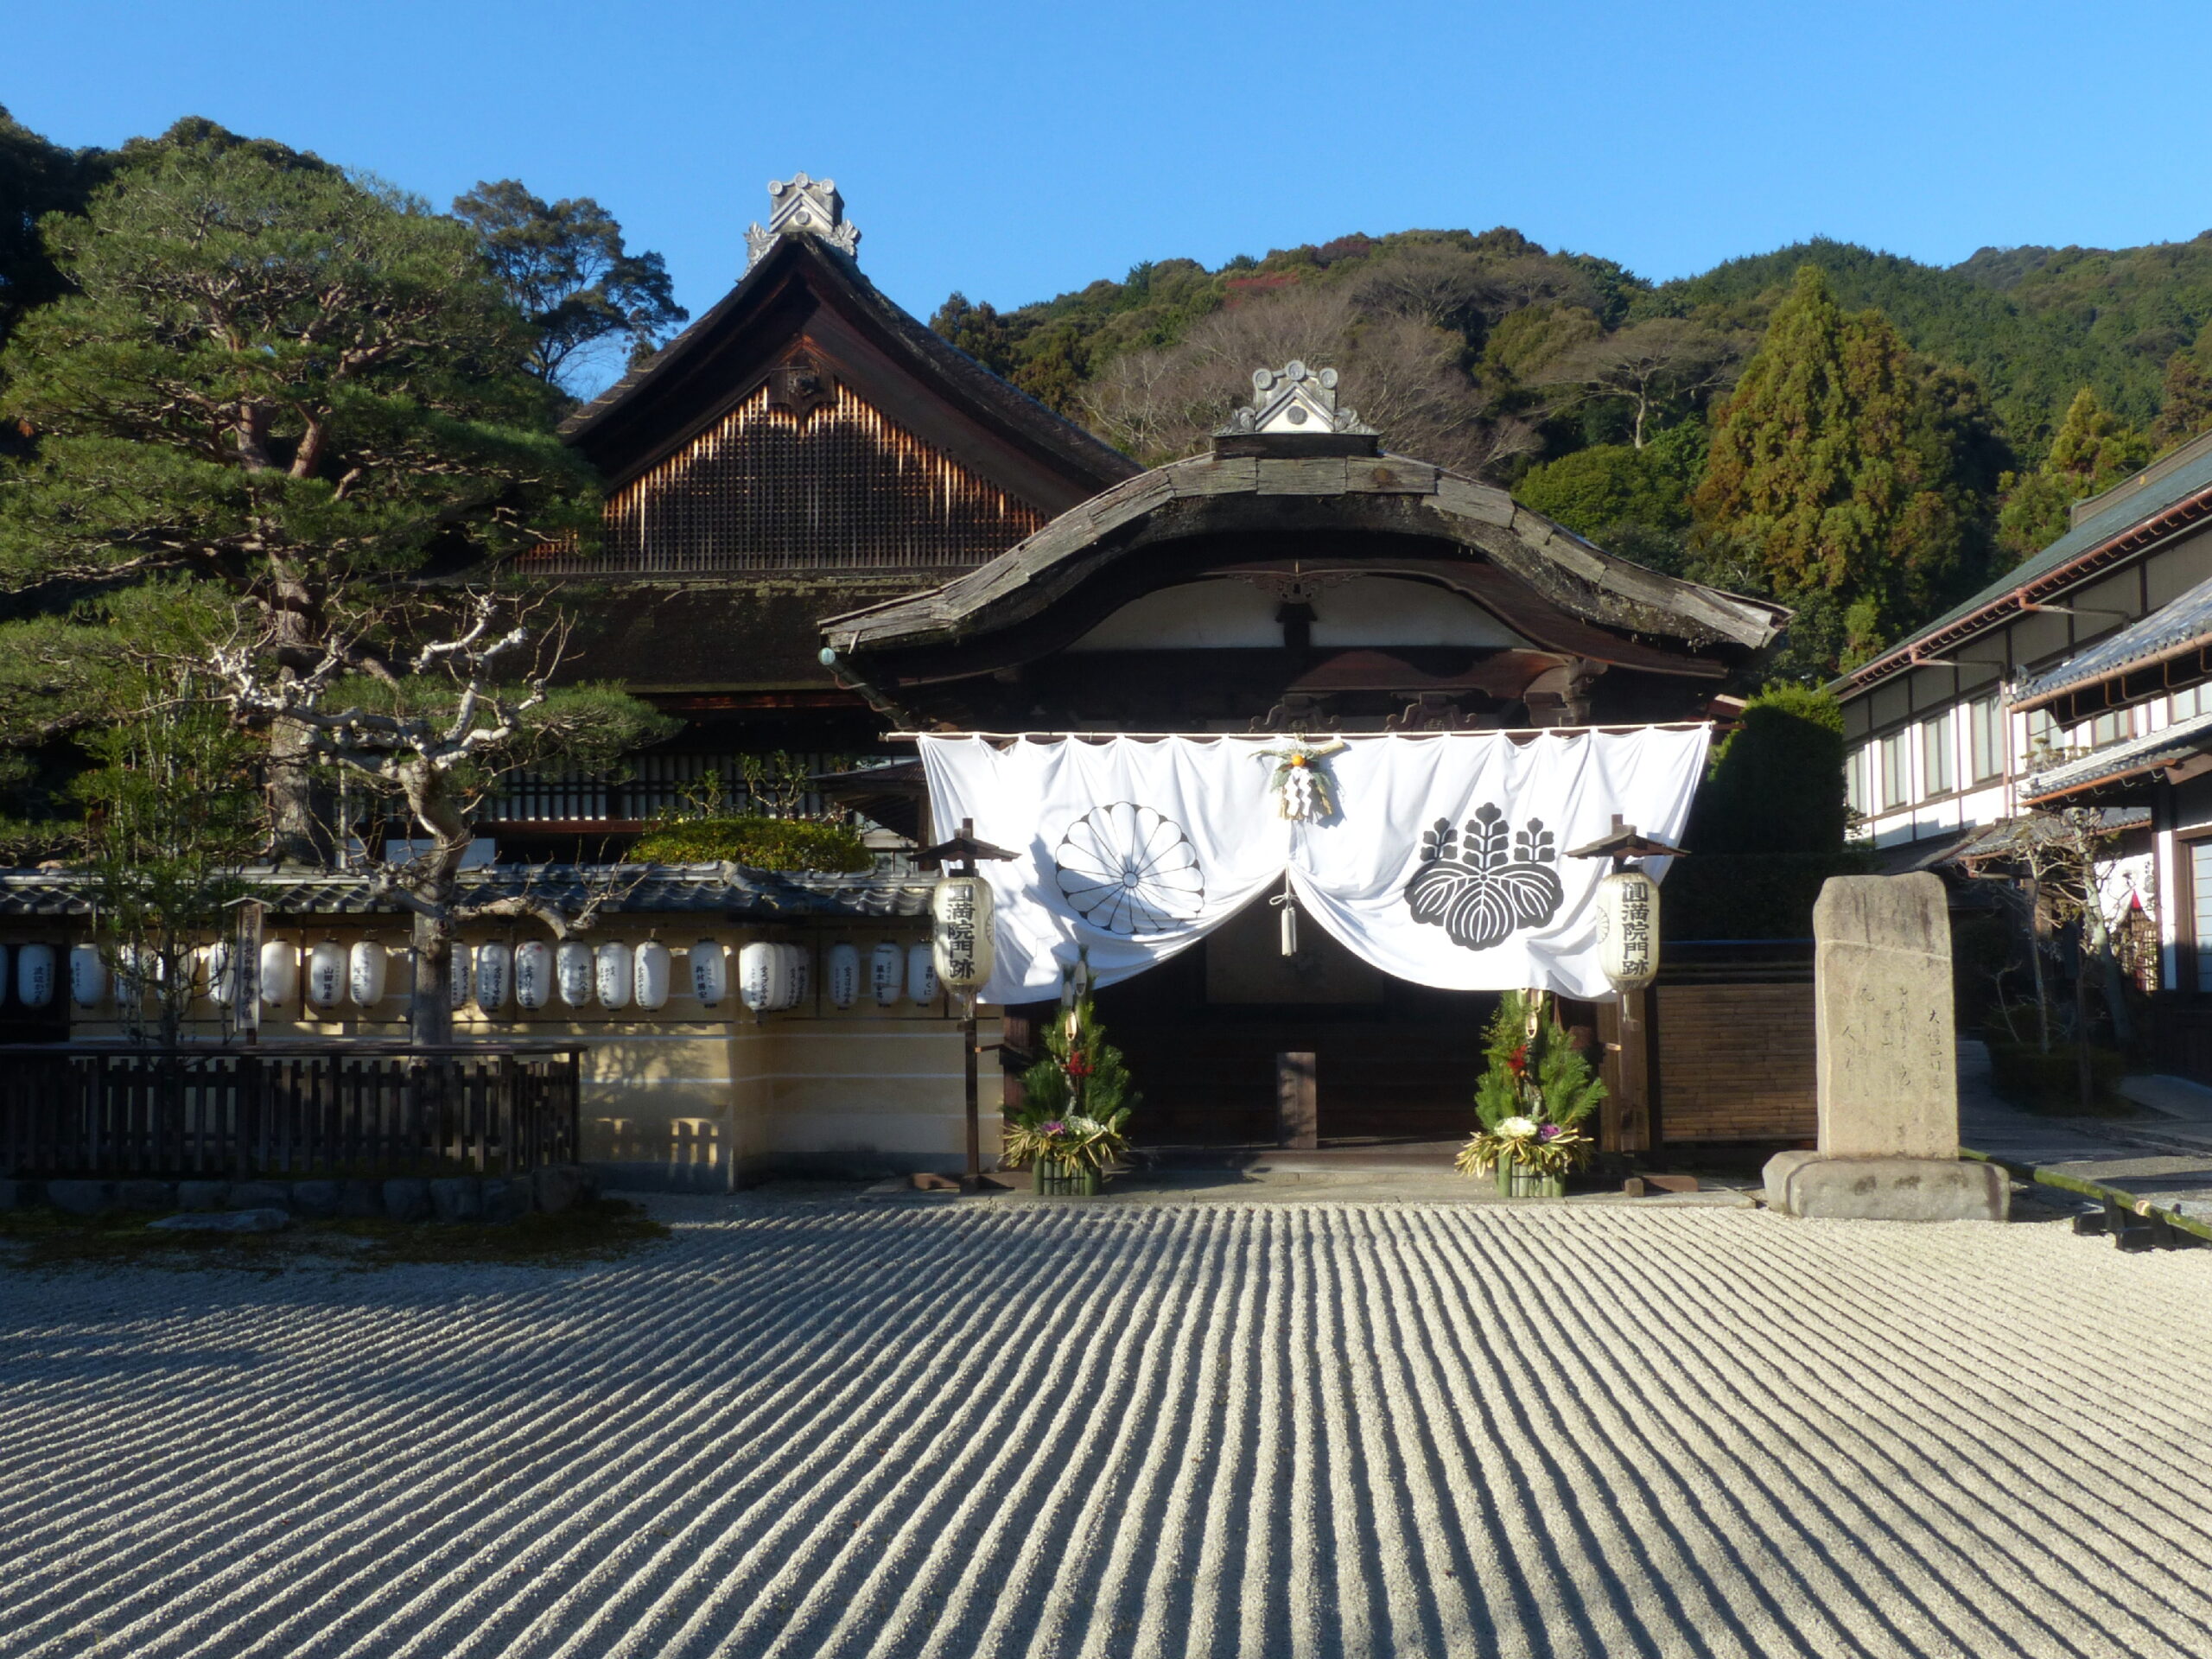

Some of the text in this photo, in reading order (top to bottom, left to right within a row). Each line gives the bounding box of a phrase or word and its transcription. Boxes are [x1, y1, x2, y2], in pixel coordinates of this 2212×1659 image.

[947, 884, 976, 979] 圓満院門跡
[1621, 881, 1649, 976] 圓満院門跡
